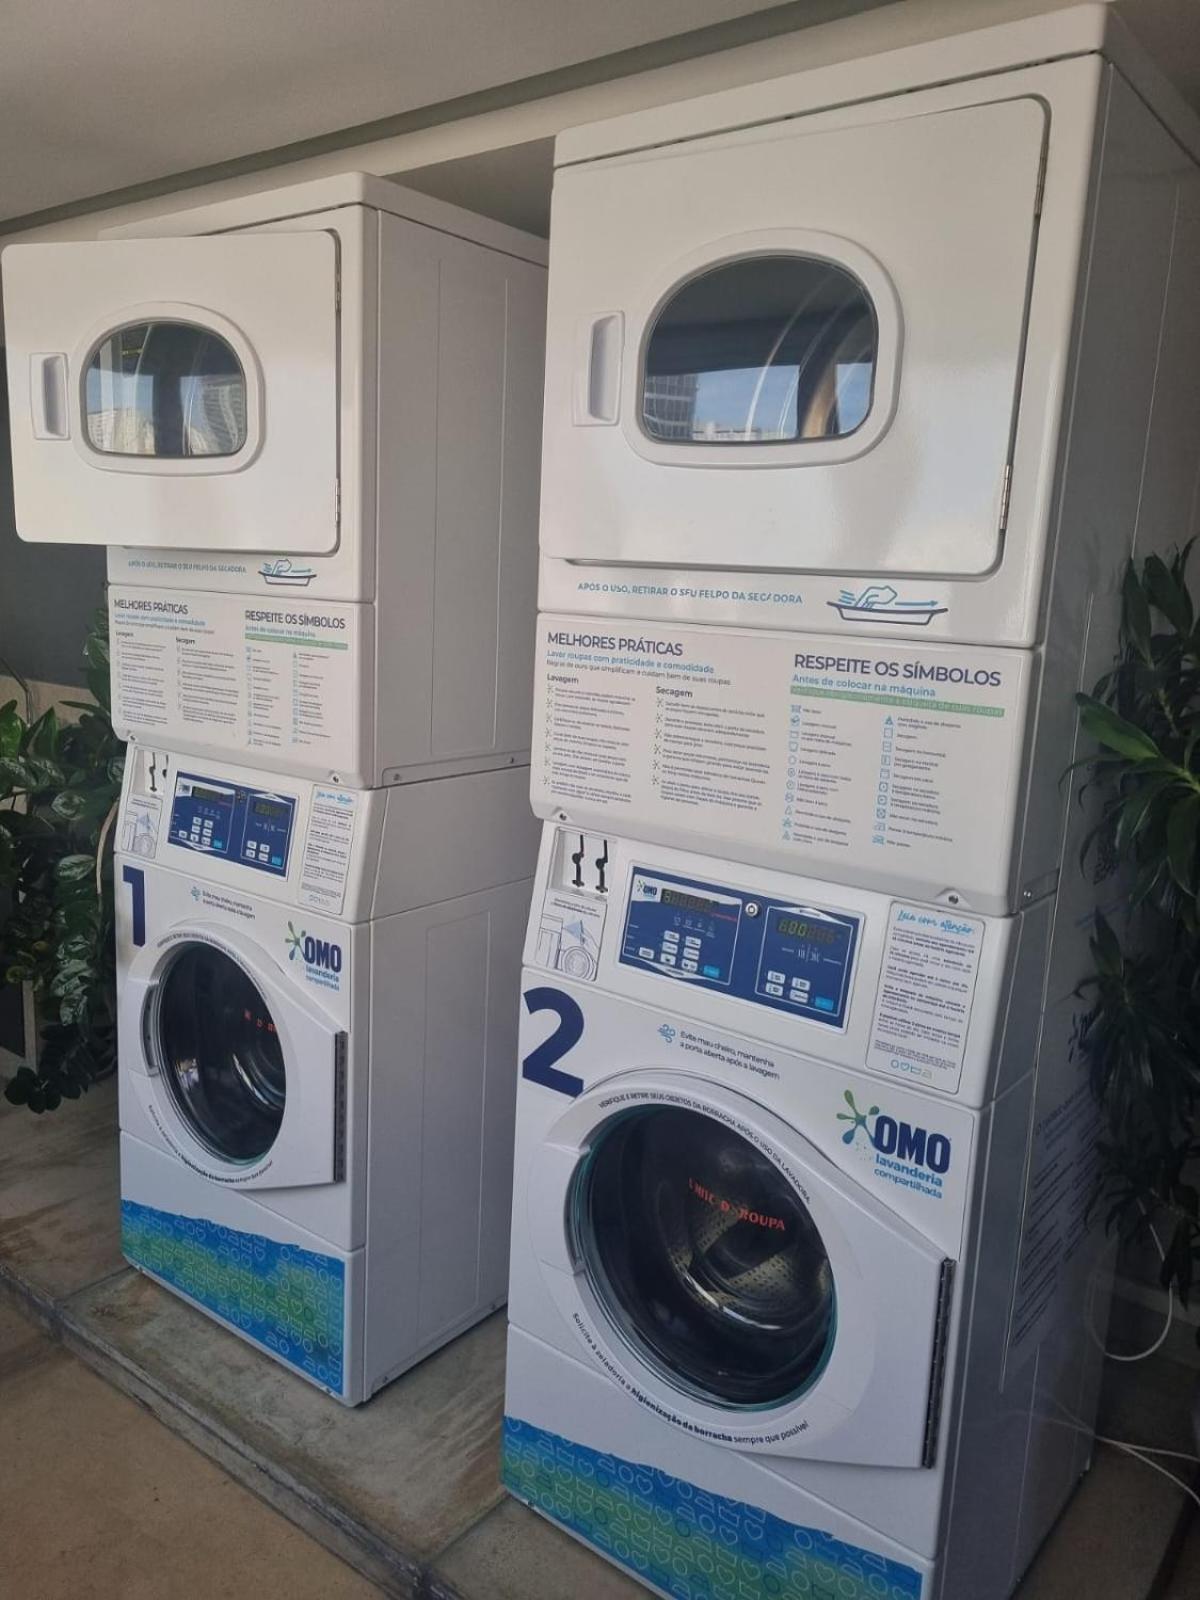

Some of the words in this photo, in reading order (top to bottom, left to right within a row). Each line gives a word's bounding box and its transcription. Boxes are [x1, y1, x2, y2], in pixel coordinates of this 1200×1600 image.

[114, 599, 152, 611] MELHORES
[578, 582, 600, 591] APÓS
[602, 584, 609, 592] O
[632, 585, 668, 595] RETIRAR
[670, 588, 678, 596] O
[700, 590, 729, 600] FELPO
[731, 591, 746, 600] DA
[245, 610, 284, 624] RESPEITE
[285, 614, 298, 625] OS
[298, 614, 346, 629] SÍMBOLOS
[547, 631, 616, 650] MELHORES
[618, 637, 684, 657] PRÁTICAS
[547, 673, 579, 684] Lavagem
[611, 656, 655, 668] praticidade
[663, 661, 714, 674] comodidade
[794, 653, 872, 675] RESPEITE
[875, 661, 900, 677] OS
[902, 660, 1002, 687] SÍMBOLOS
[656, 686, 693, 698] Secagem
[792, 674, 819, 684] Antes
[821, 677, 834, 687] de
[836, 679, 872, 691] colocar
[874, 683, 887, 692] na
[889, 684, 936, 697] máquina
[122, 865, 146, 948] 1
[304, 936, 342, 973] OMO
[522, 986, 585, 1100] 2
[680, 1031, 697, 1042] Evite
[698, 1038, 713, 1048] mau
[737, 1050, 775, 1068] mantenha
[685, 1043, 703, 1055] porta
[704, 1049, 725, 1062] aberta
[726, 1056, 743, 1068] após
[749, 1063, 780, 1080] lavagem
[873, 1115, 951, 1174] OMO
[760, 1142, 773, 1156] USO
[781, 1162, 810, 1203] LAVADORA
[873, 1168, 943, 1199] compartilhada
[875, 1153, 943, 1188] lavanderia
[739, 1206, 785, 1231] ROUPA
[572, 1312, 593, 1344] Solicite
[595, 1350, 626, 1386] zeladoria
[631, 1387, 682, 1426] higienização
[682, 1421, 693, 1431] da
[694, 1425, 732, 1442] borracha
[733, 1436, 764, 1446] sempre
[764, 1433, 780, 1444] que
